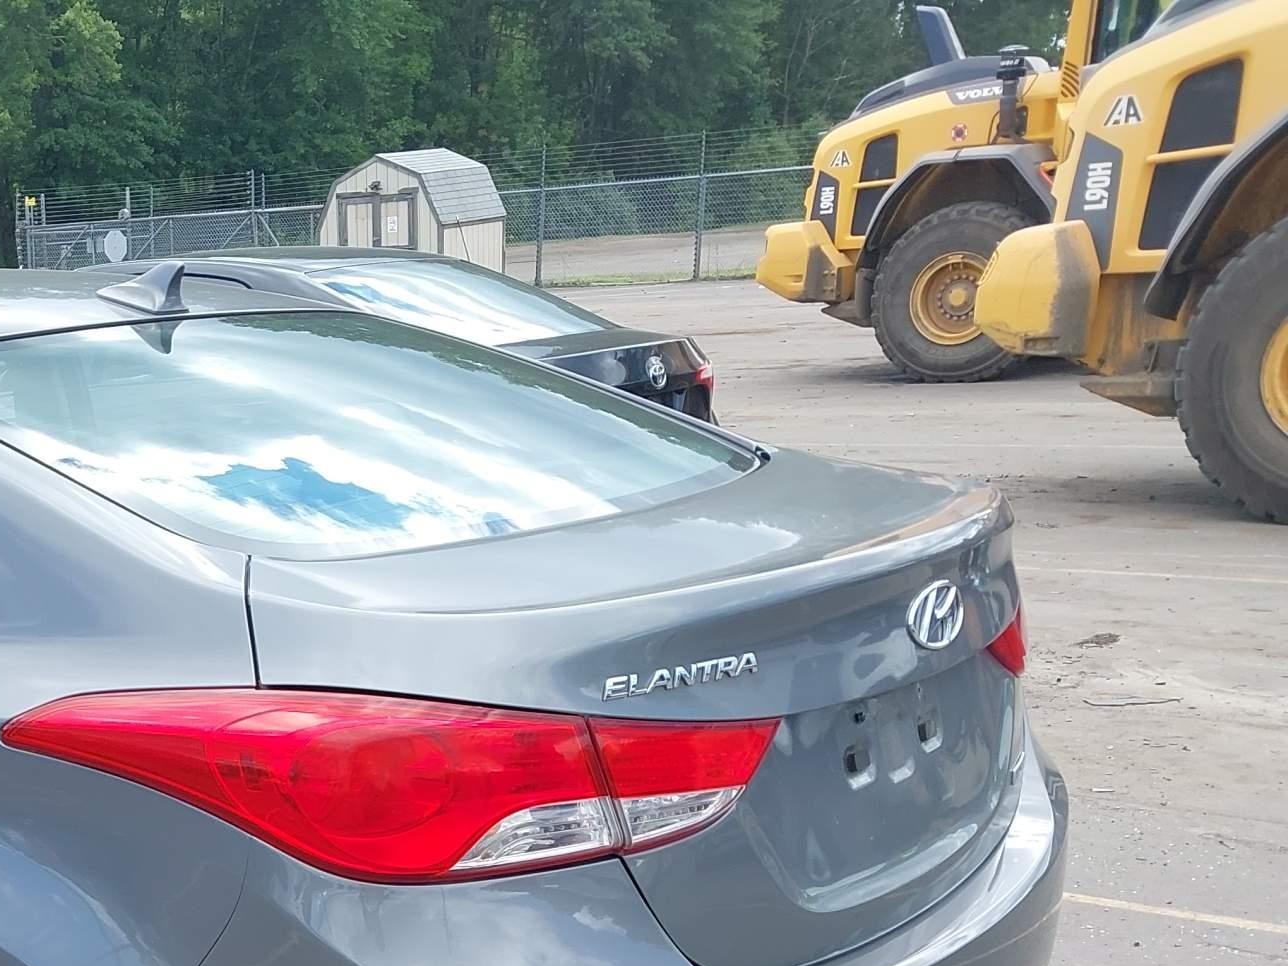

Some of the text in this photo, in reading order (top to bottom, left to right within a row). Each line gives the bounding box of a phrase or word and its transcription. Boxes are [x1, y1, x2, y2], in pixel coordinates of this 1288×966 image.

[955, 86, 1004, 100] VOLV
[820, 186, 836, 215] L90H
[1083, 162, 1113, 211] L90H
[603, 652, 758, 701] ELANTRA
